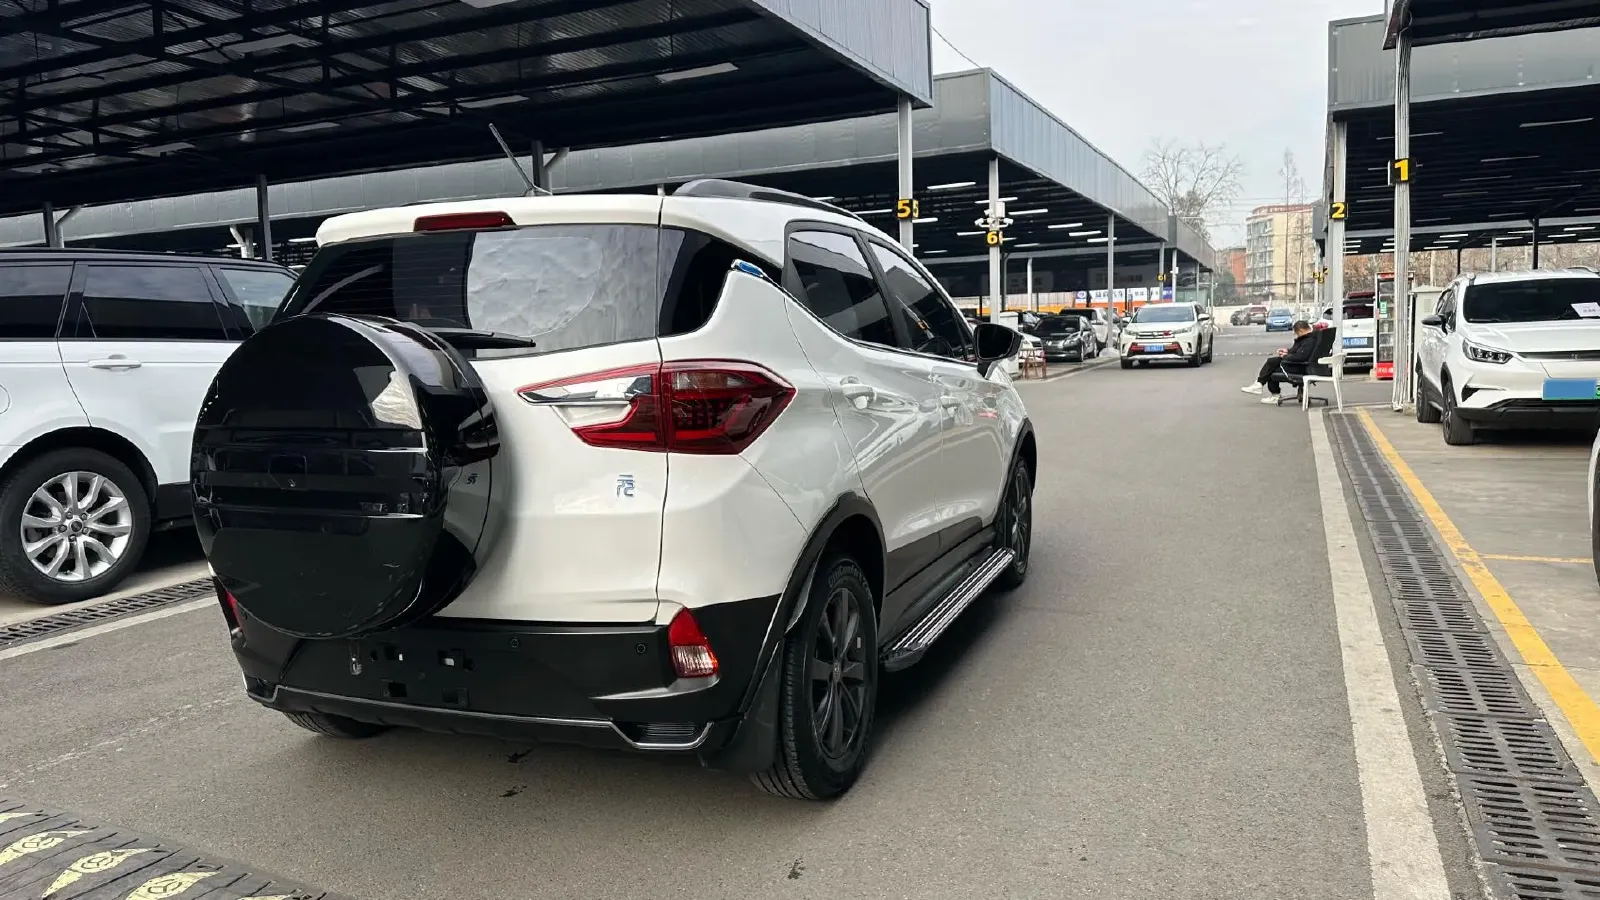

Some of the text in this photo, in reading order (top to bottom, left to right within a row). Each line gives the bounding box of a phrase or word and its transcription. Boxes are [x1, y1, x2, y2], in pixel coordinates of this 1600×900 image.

[1395, 160, 1408, 180] 1
[897, 199, 911, 218] 5
[1331, 202, 1345, 219] 2
[987, 231, 998, 245] 6
